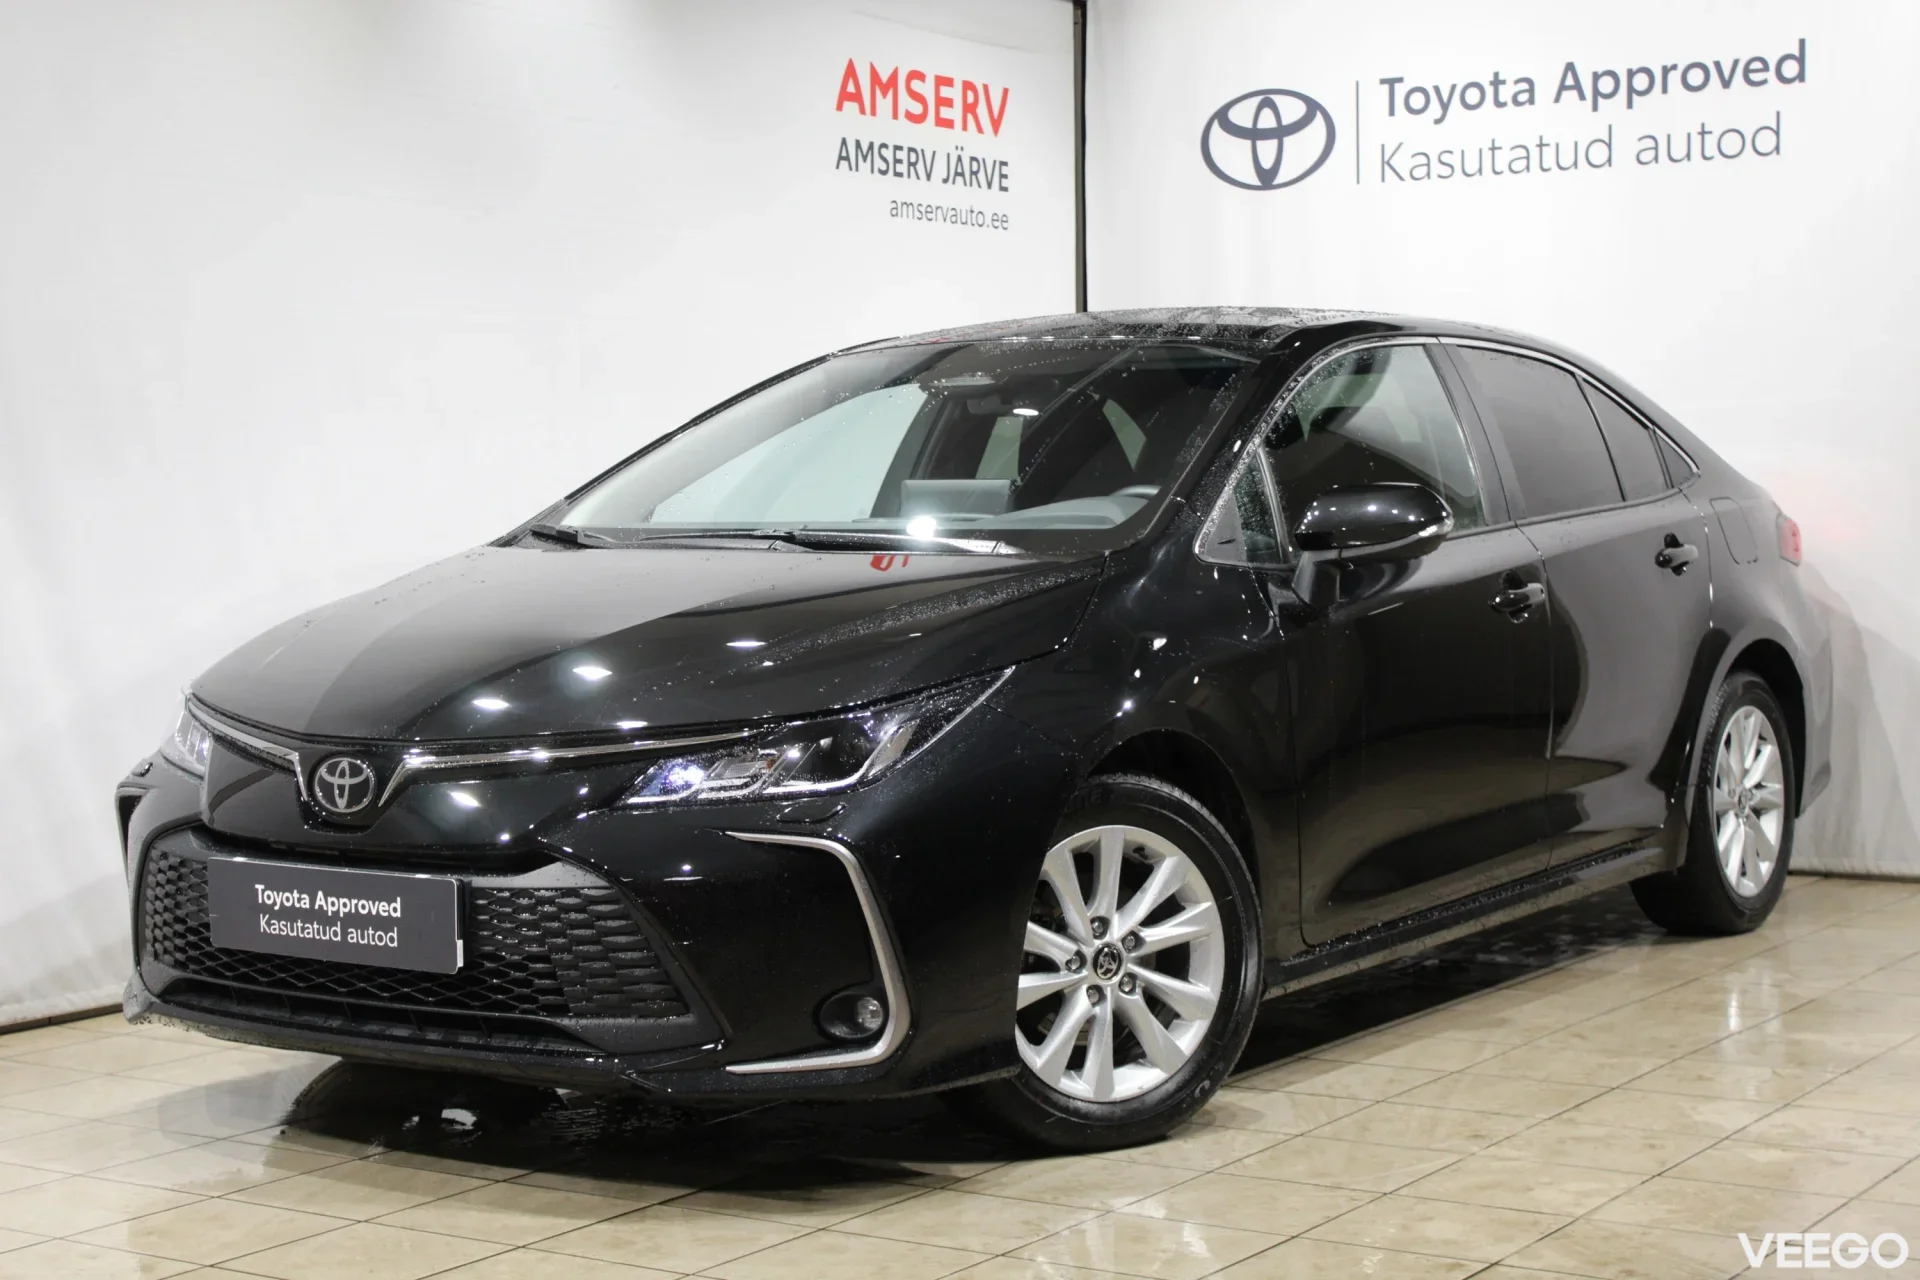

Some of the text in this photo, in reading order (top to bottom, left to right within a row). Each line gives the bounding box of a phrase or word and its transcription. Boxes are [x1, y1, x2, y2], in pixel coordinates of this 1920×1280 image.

[835, 57, 1010, 137] AMSERV
[1379, 37, 1806, 126] Toyota Approved
[835, 136, 1010, 193] AMSERV JÄRVE
[1380, 110, 1781, 183] Kasutatud autod
[889, 199, 1010, 231] amservauto.ee
[254, 883, 402, 918] Toyota Approved
[259, 913, 398, 948] Kasutatud autod
